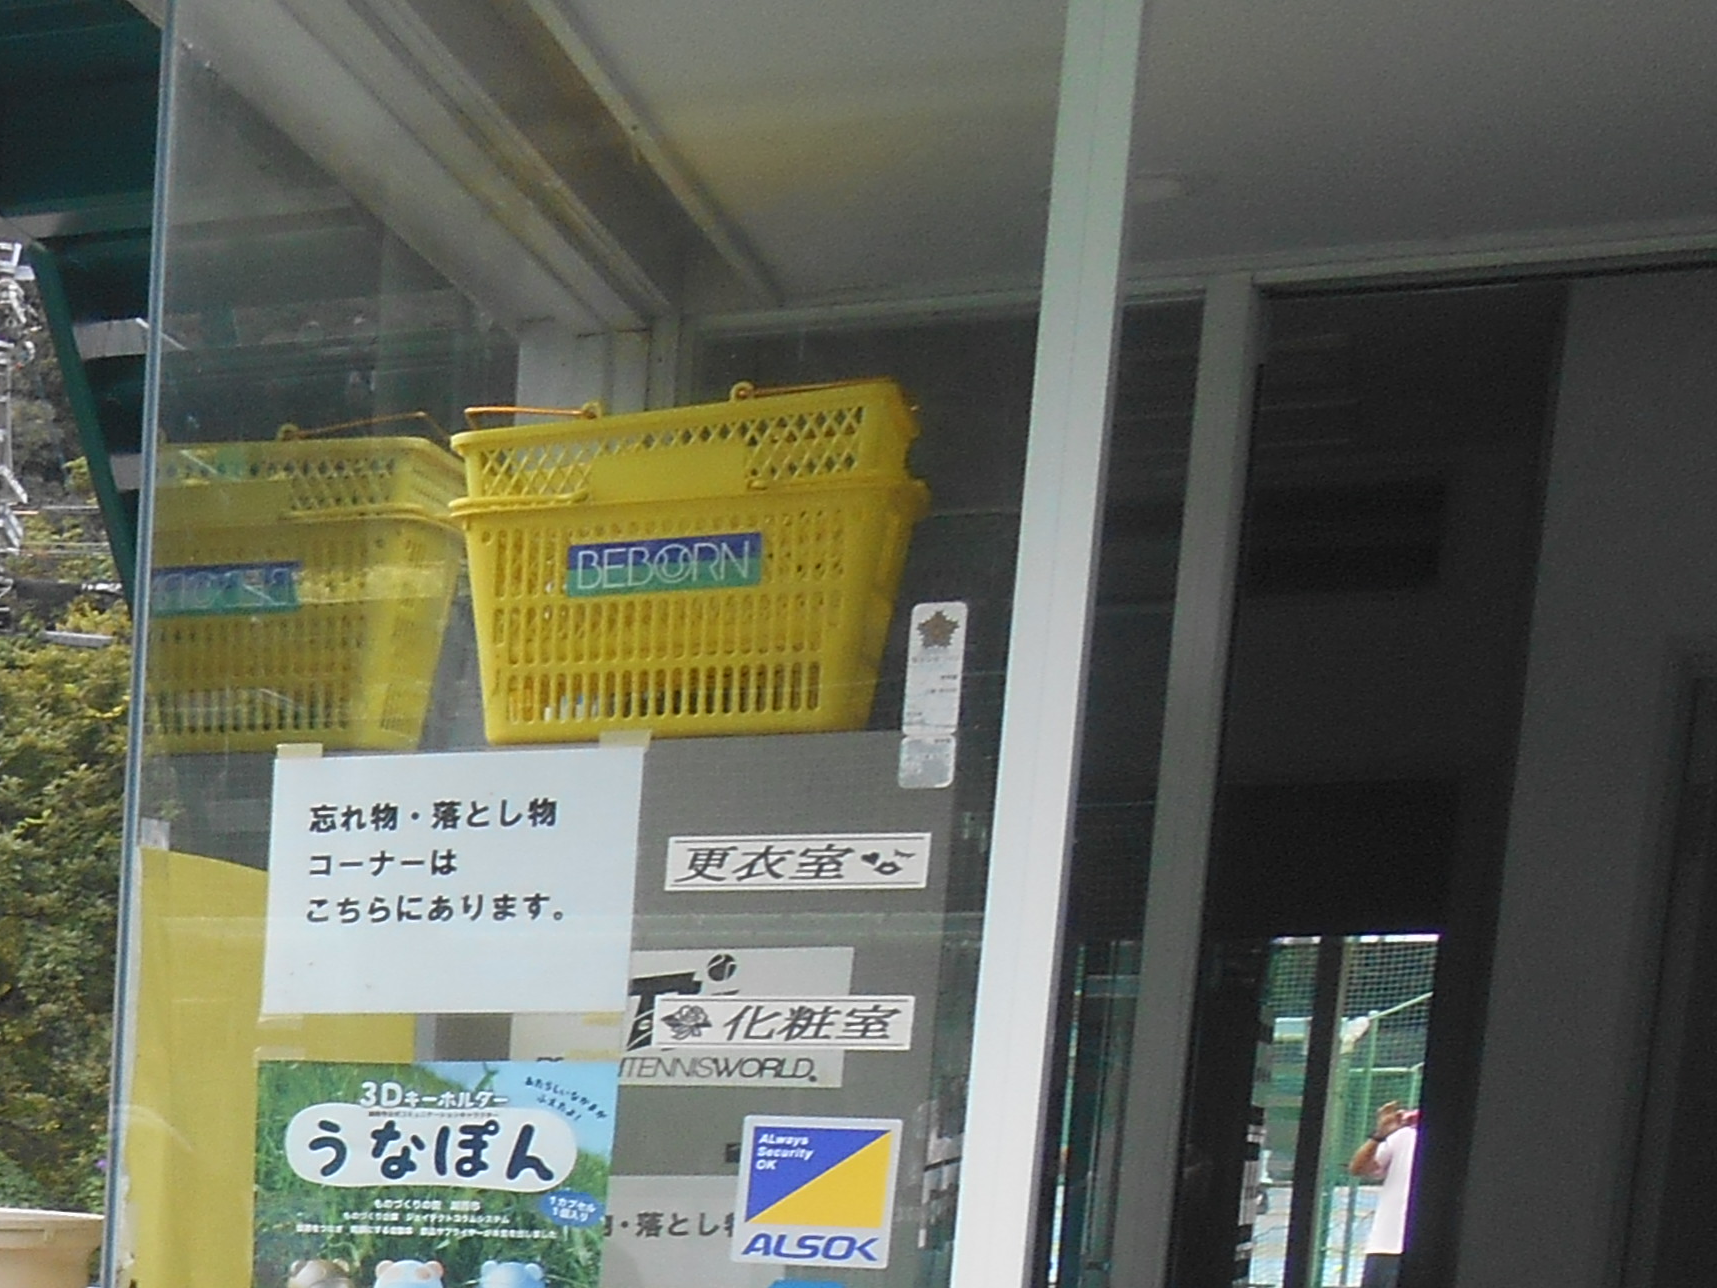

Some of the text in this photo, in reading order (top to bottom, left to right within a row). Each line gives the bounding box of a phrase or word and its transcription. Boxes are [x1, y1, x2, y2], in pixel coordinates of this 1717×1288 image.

[577, 540, 750, 590] BEBORN
[309, 797, 558, 833] 忘れ物・落とし物
[309, 848, 458, 877] コーナーは
[674, 843, 855, 882] 更衣室
[306, 892, 564, 924] こちらにあります。
[722, 1003, 902, 1042] 化粧室
[360, 1081, 509, 1108] 3Dキーホルダー
[308, 1119, 555, 1182] うなぽん
[755, 1159, 778, 1170] OK
[757, 1146, 814, 1161] Security
[741, 1232, 880, 1262] ALSOK
